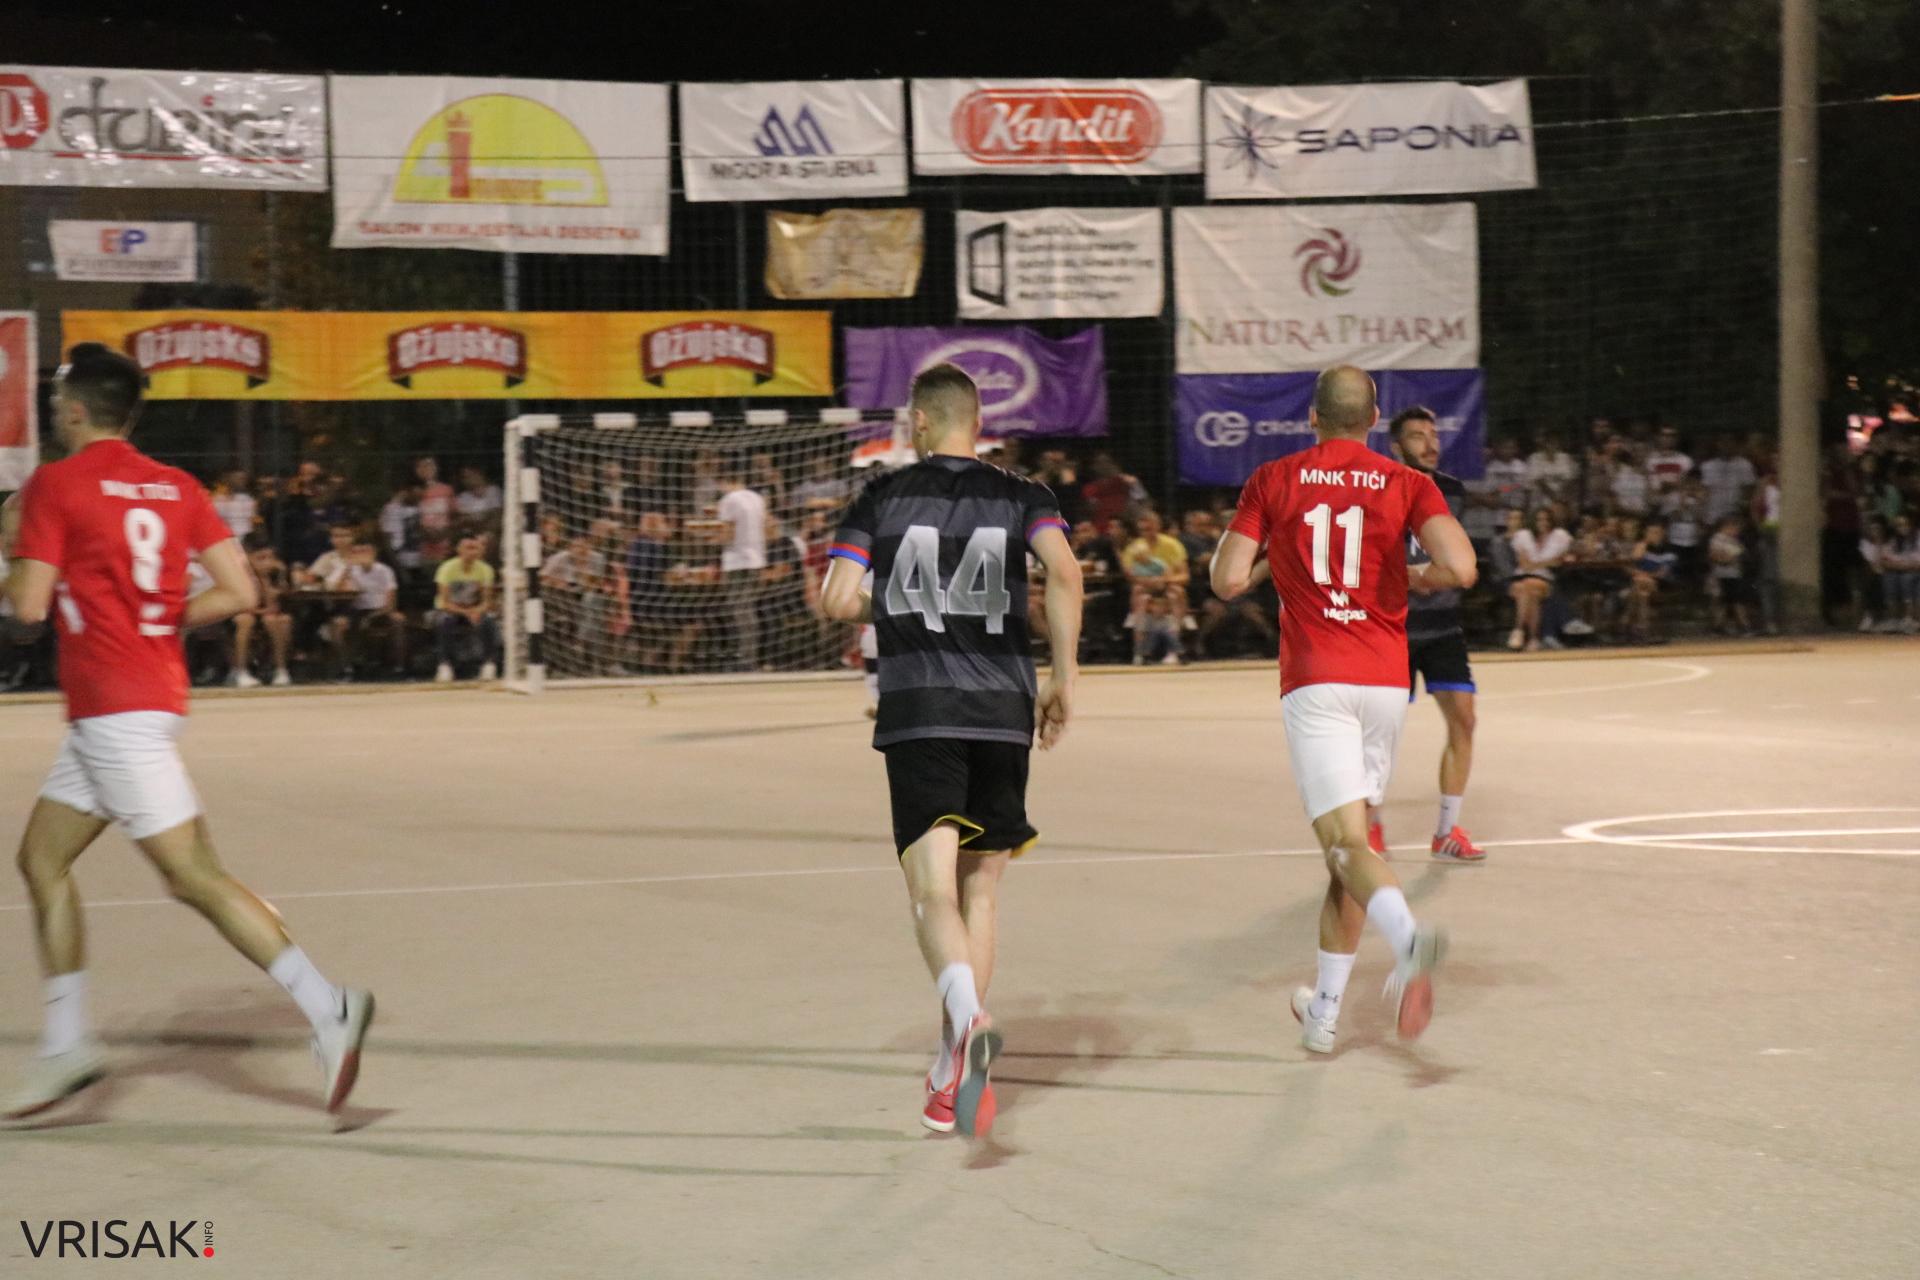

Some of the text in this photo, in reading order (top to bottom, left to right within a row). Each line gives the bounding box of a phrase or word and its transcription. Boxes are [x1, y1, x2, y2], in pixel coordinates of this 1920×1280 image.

[978, 102, 1135, 151] Kandit
[1298, 123, 1522, 154] SAPONIA
[100, 227, 148, 255] EP
[1300, 469, 1386, 490] MNK TIĆI
[123, 507, 166, 594] 8
[1303, 503, 1364, 589] 11
[885, 524, 1011, 635] 44
